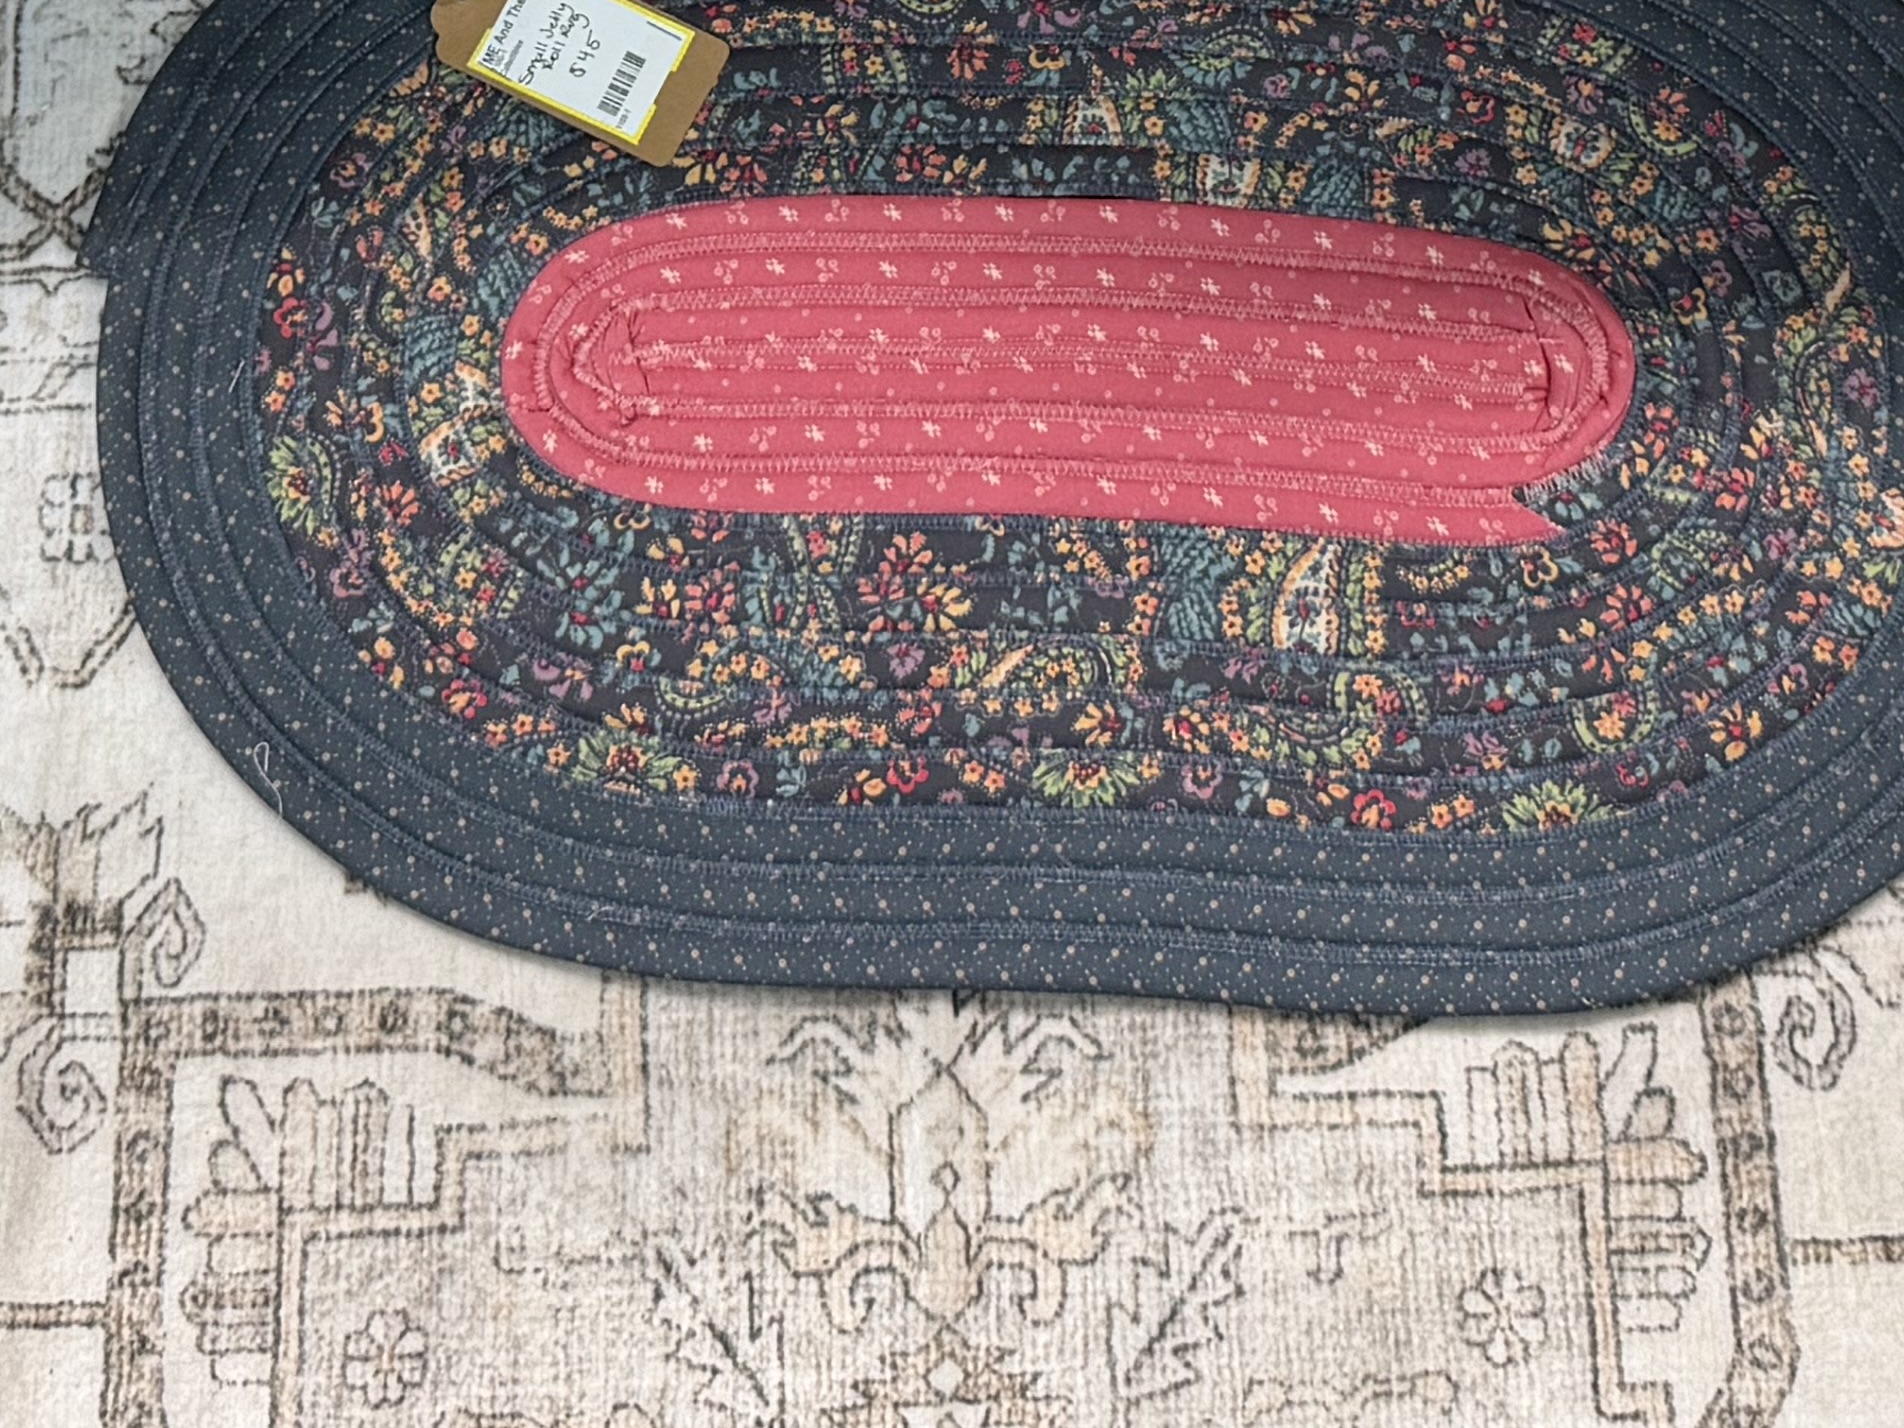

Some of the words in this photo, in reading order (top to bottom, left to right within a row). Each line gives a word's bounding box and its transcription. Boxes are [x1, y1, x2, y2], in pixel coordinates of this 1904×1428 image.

[482, 44, 497, 65] ME
[493, 20, 514, 45] And
[518, 41, 548, 85] Small
[539, 3, 575, 39] Jelly
